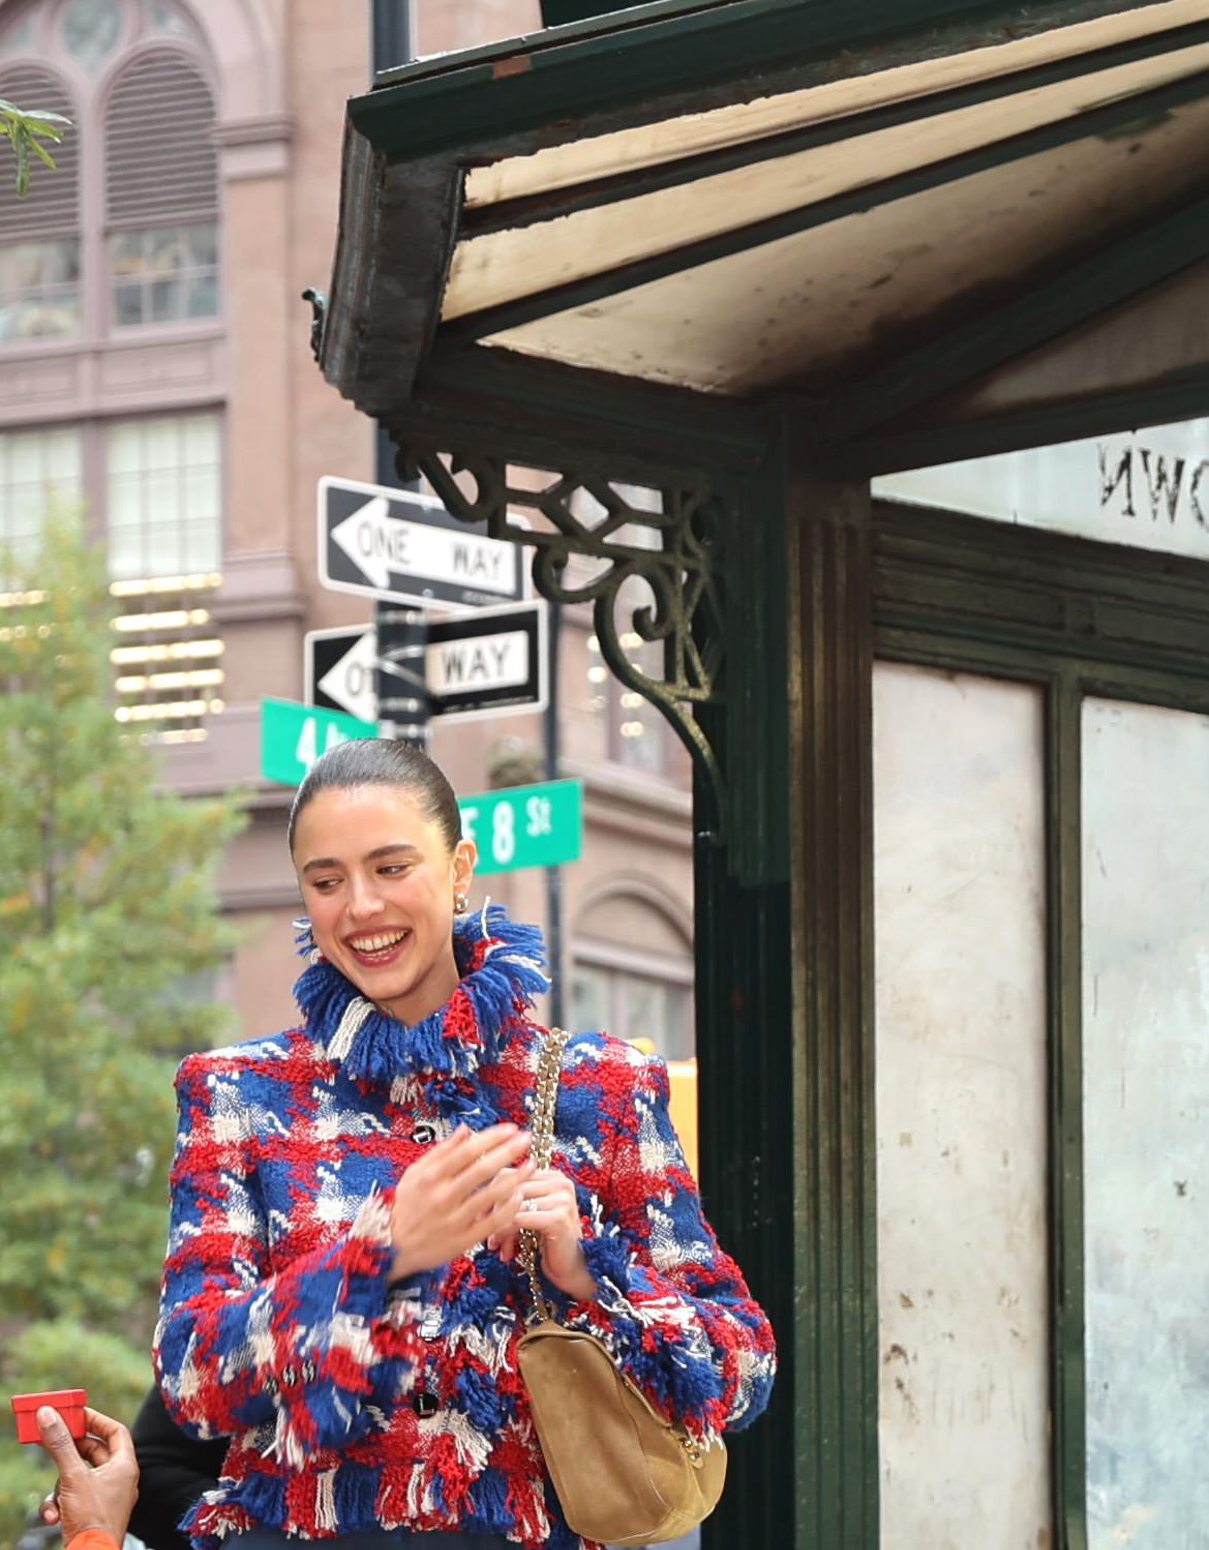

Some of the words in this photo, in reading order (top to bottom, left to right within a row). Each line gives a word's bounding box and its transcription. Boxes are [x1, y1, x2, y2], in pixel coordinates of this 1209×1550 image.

[357, 521, 410, 565] ONE
[452, 539, 505, 580] WAY
[441, 637, 511, 684] WAY
[492, 800, 515, 865] 8
